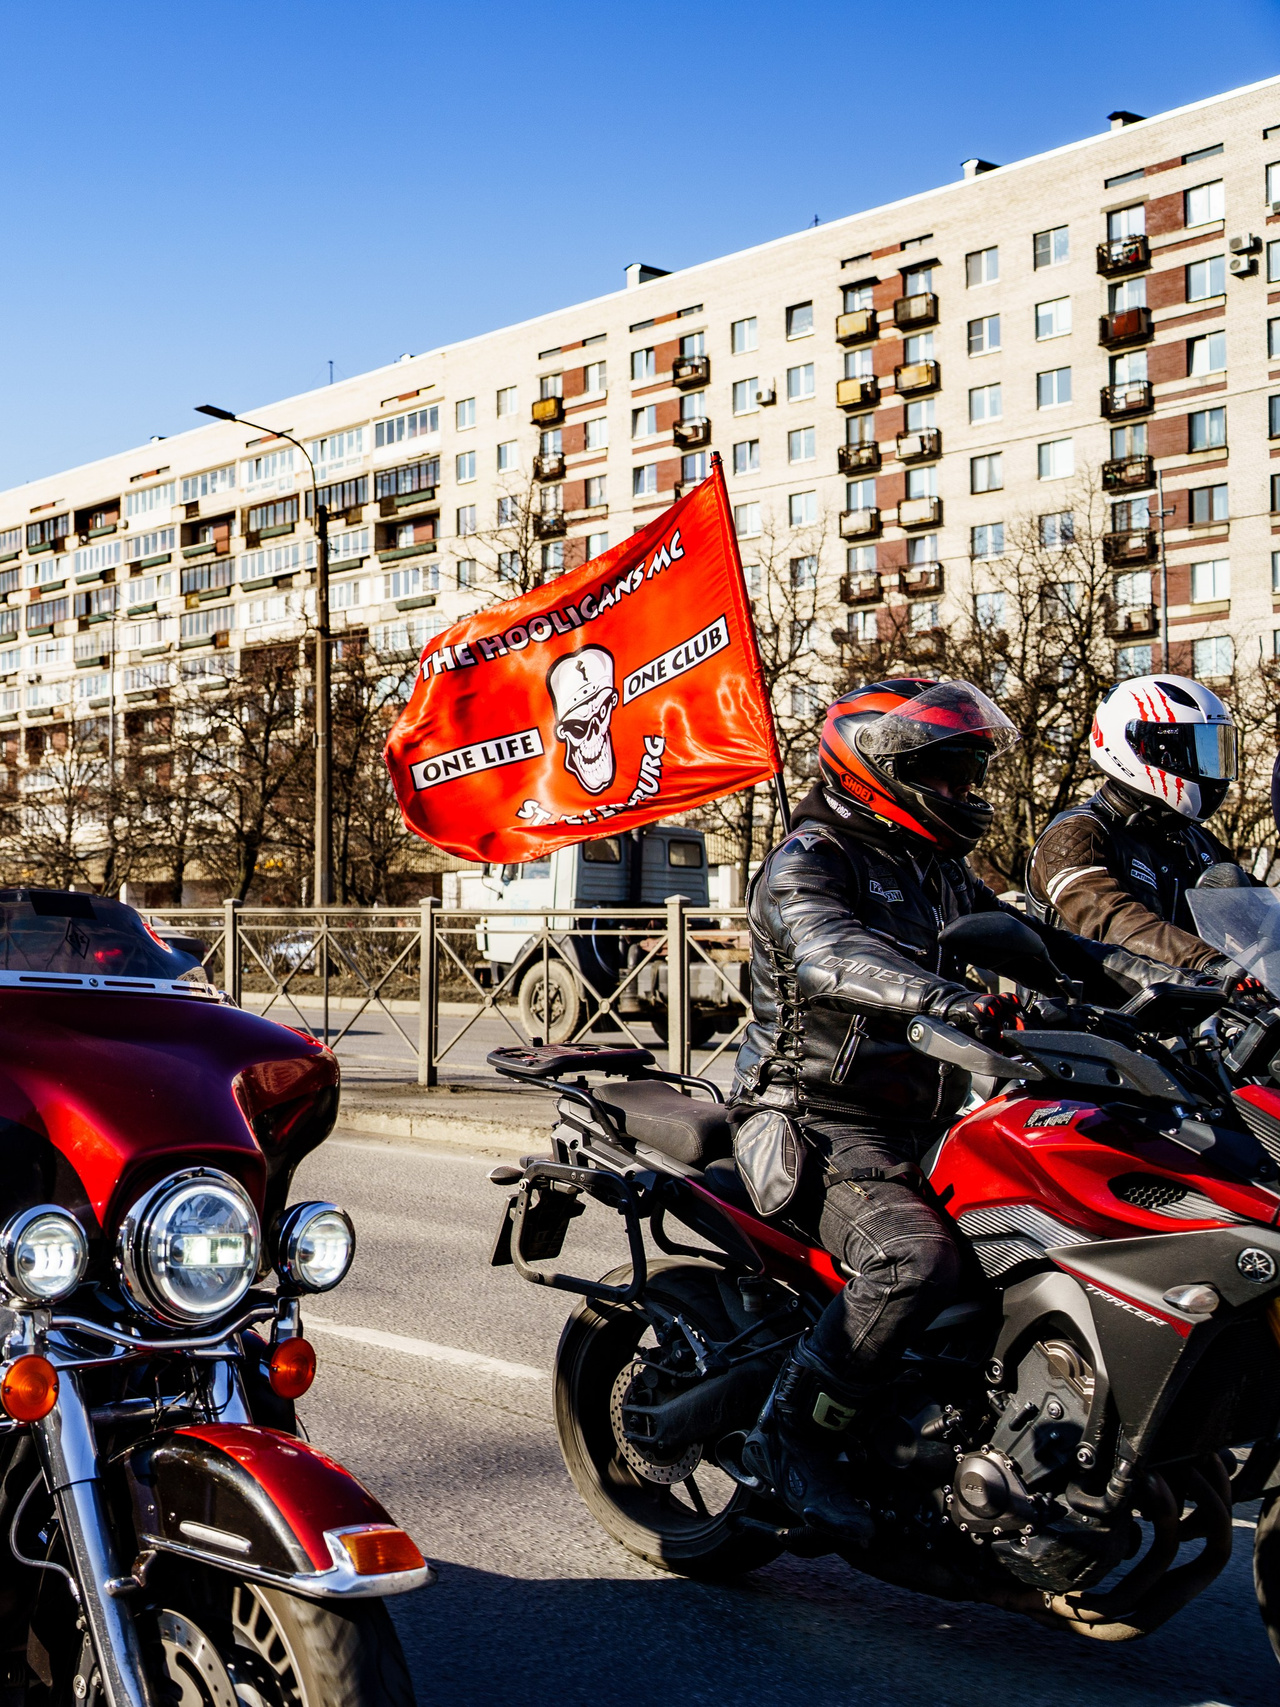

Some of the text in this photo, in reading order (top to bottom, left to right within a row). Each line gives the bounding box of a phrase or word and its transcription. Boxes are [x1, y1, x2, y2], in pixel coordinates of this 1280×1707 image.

[420, 528, 686, 682] THE HOOLIGANS MC
[628, 626, 722, 696] ONE CLUB
[422, 734, 535, 782] ONE LIFE
[843, 774, 873, 802] SHOEI
[818, 954, 933, 989] DAINESE
[1085, 1282, 1169, 1328] TRACER
